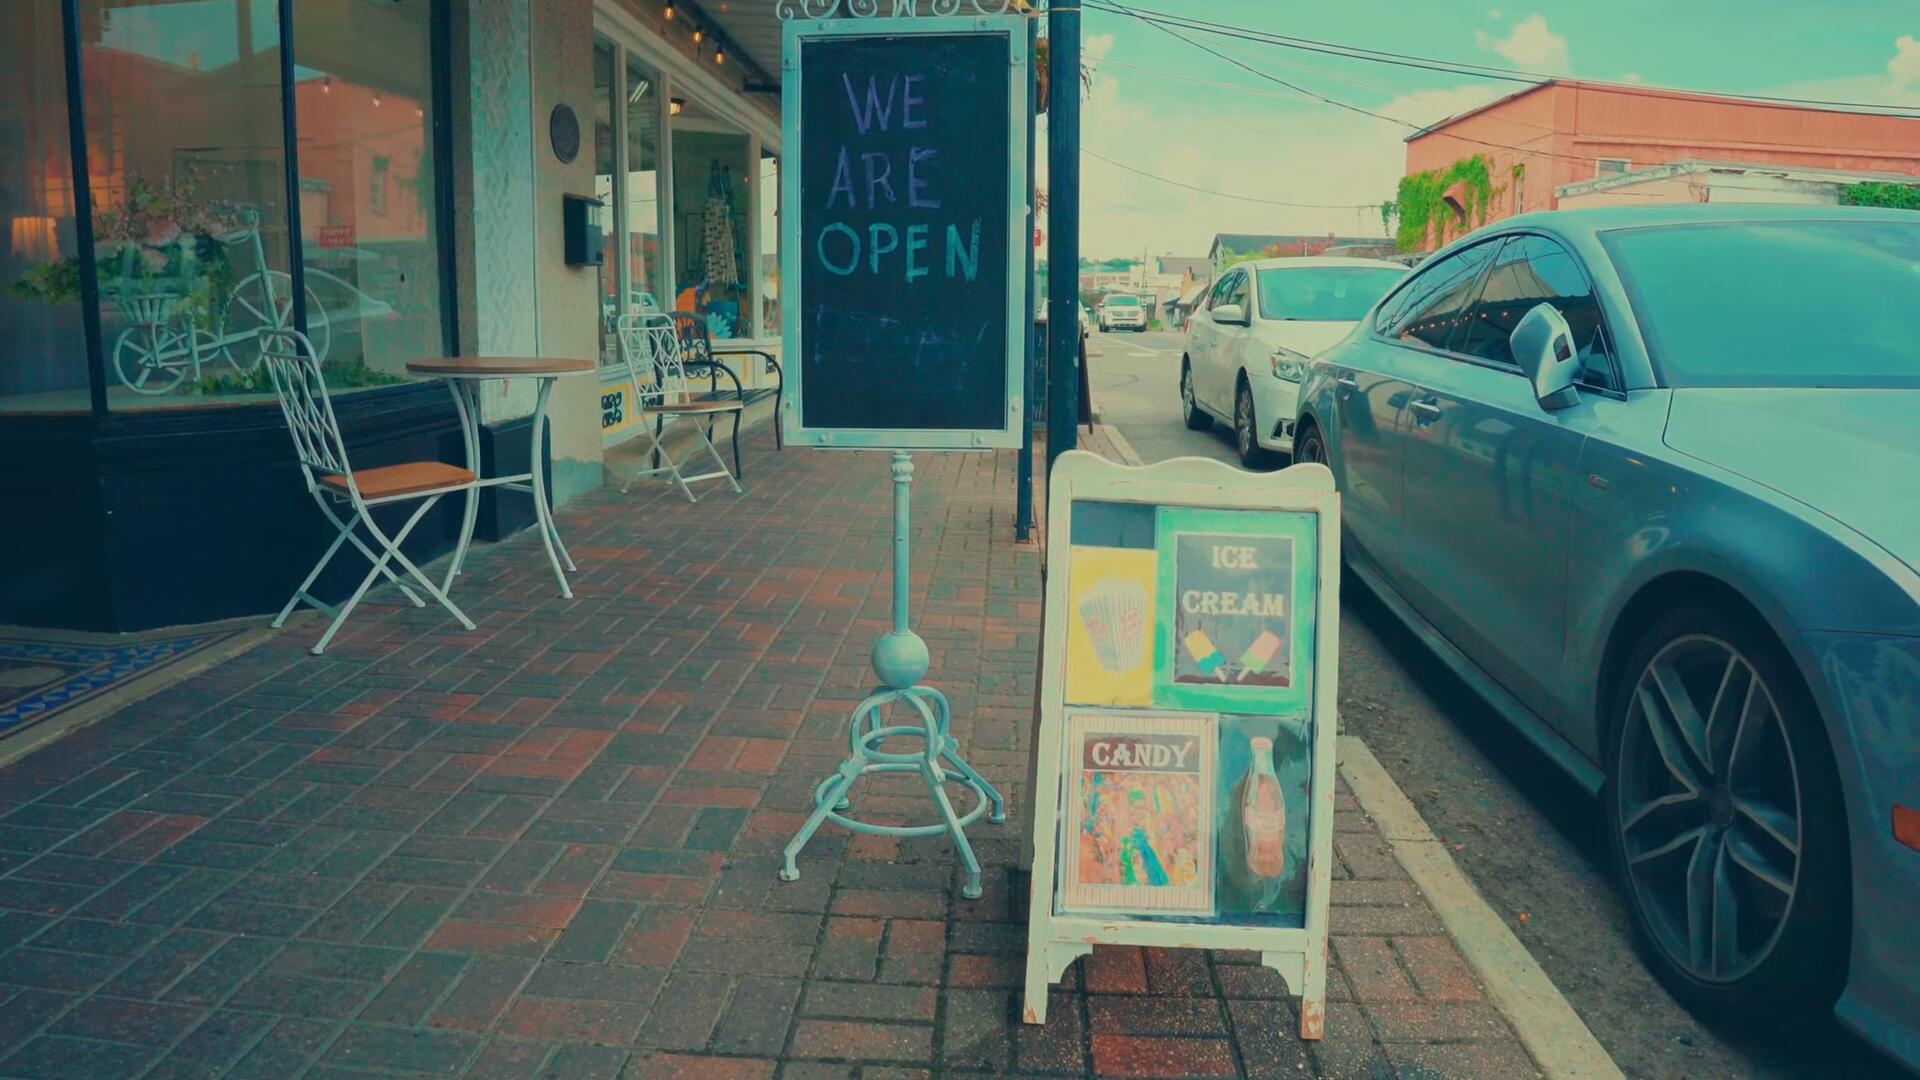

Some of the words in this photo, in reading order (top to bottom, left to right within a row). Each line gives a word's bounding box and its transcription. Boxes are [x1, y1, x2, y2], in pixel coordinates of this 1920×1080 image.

[842, 72, 928, 135] WE
[825, 145, 941, 209] ARE
[818, 217, 982, 283] OPEN
[1211, 545, 1258, 569] ICE
[1182, 590, 1285, 617] CREAM
[1092, 740, 1194, 768] CANDY
